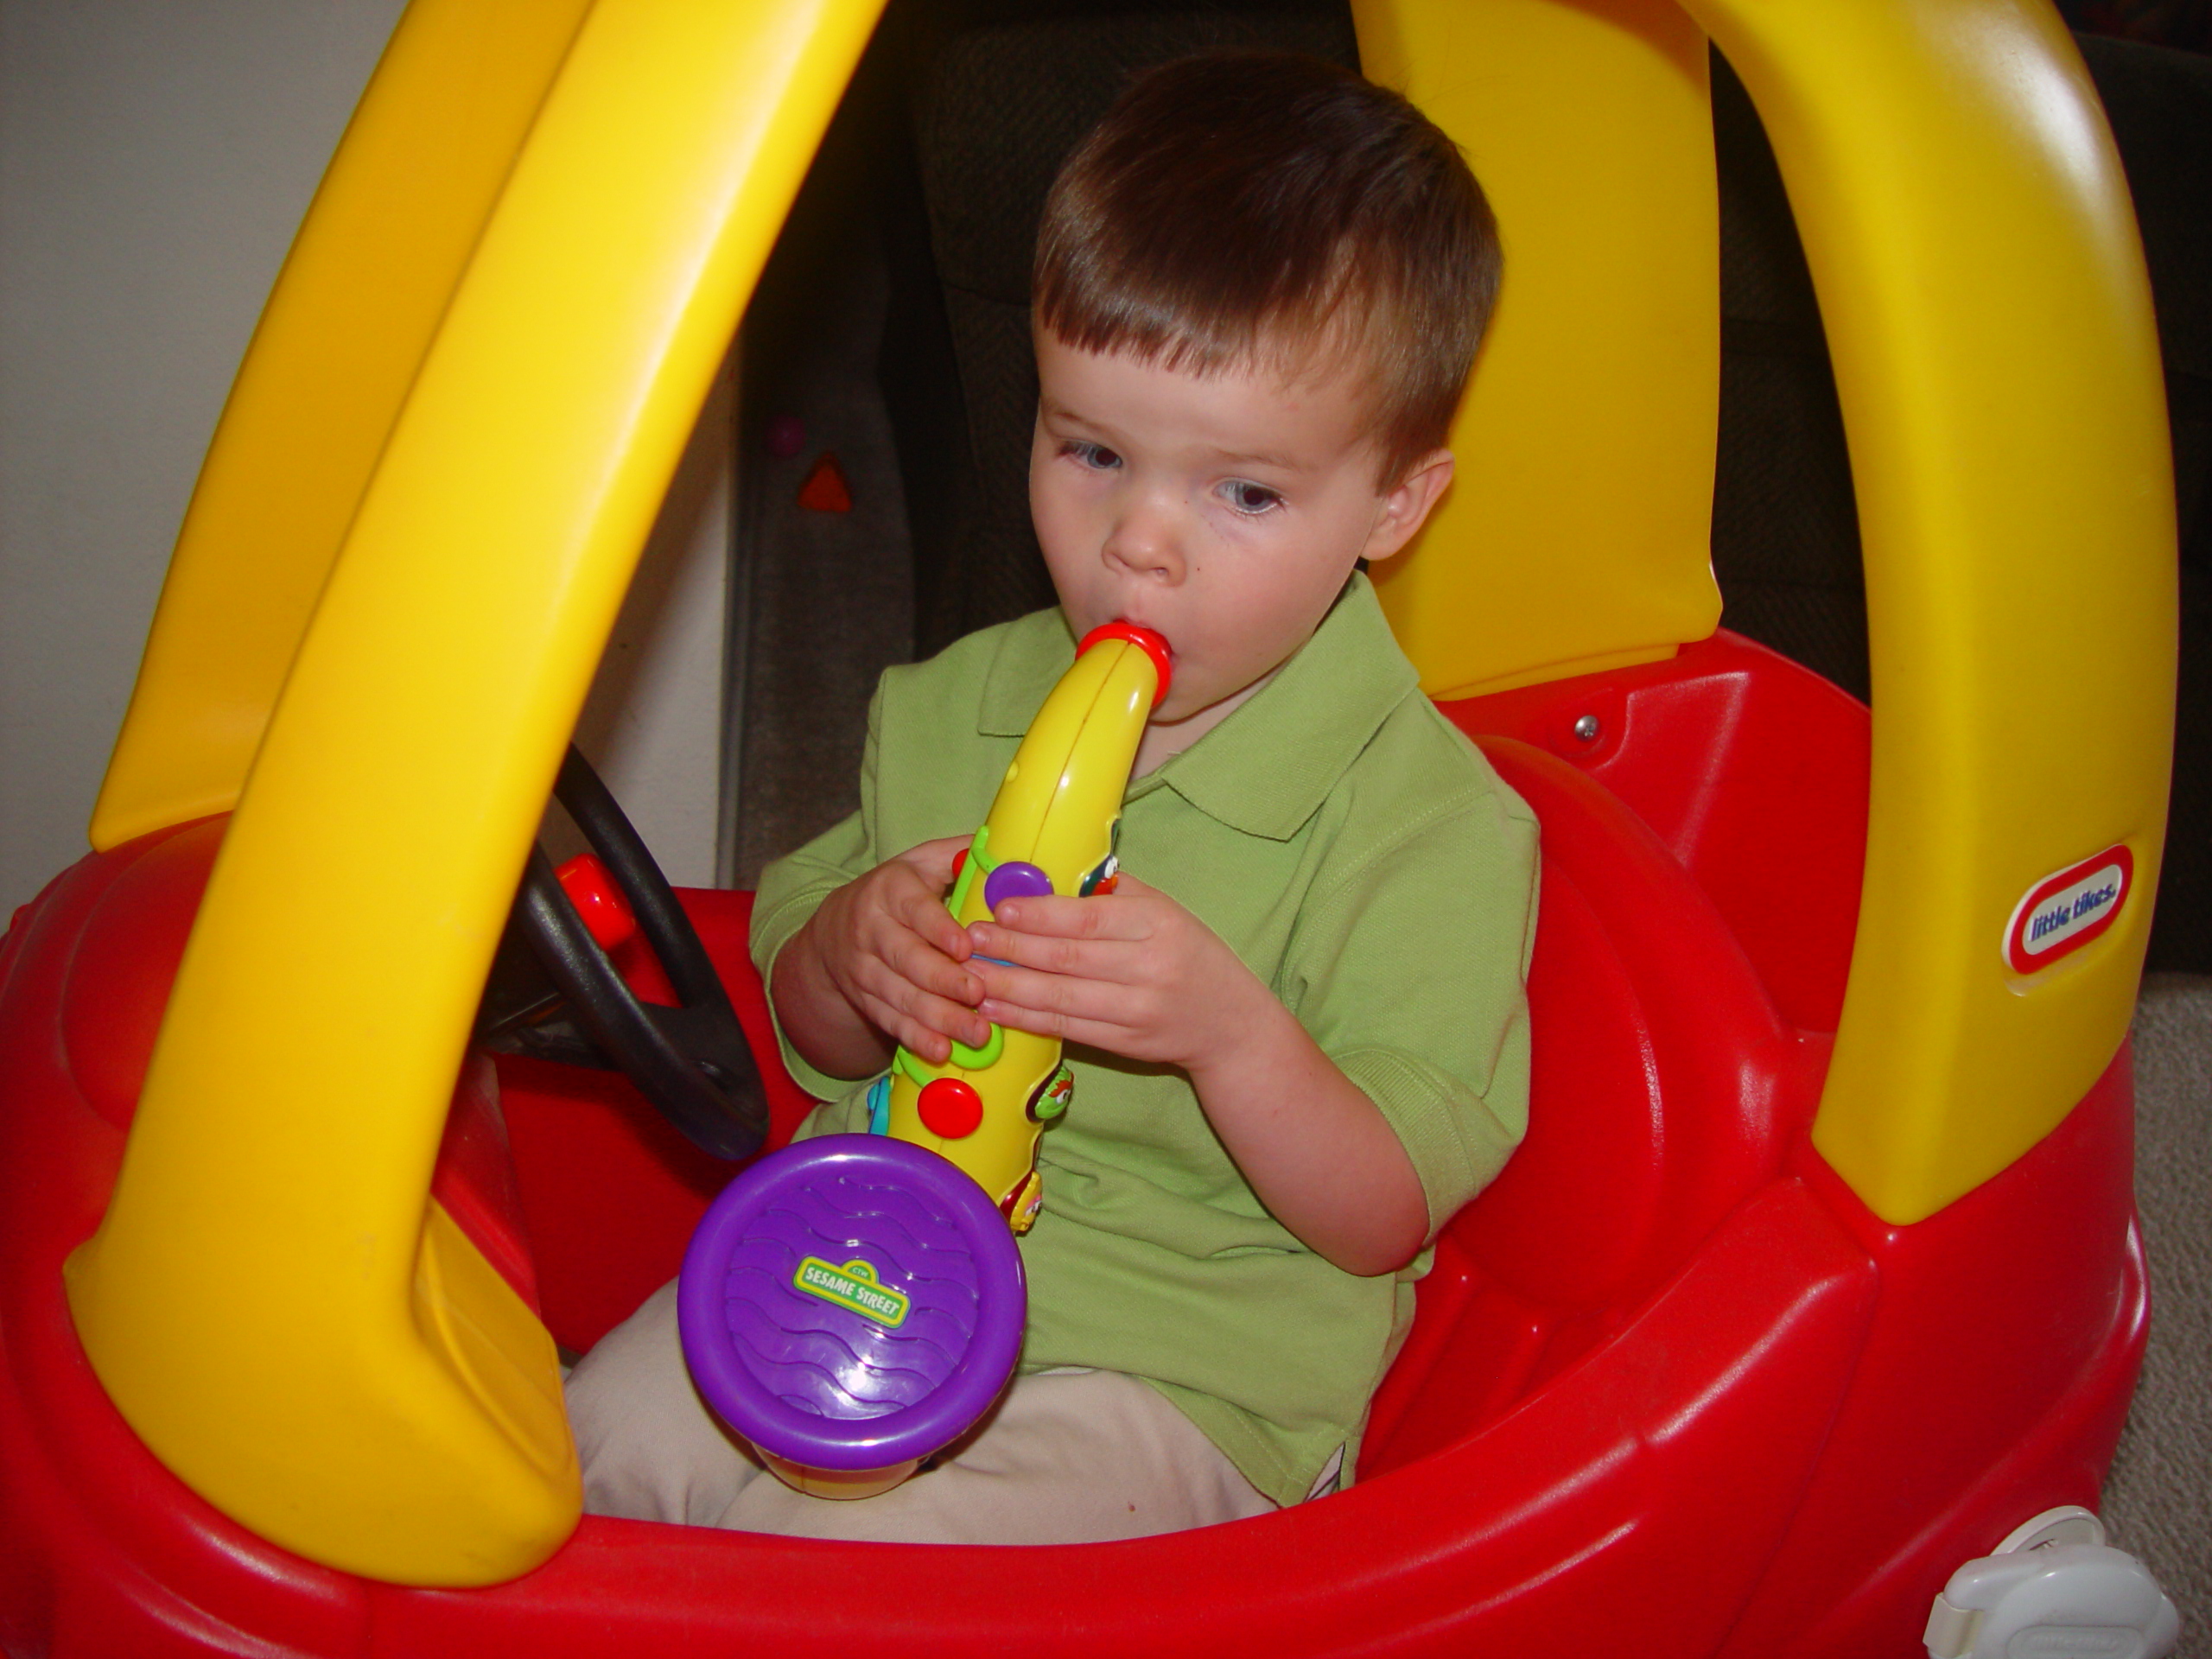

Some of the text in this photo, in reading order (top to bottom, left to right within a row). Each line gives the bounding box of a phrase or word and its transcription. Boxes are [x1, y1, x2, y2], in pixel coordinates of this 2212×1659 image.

[2030, 906, 2071, 942] little
[805, 1267, 900, 1315] SESAME STREET
